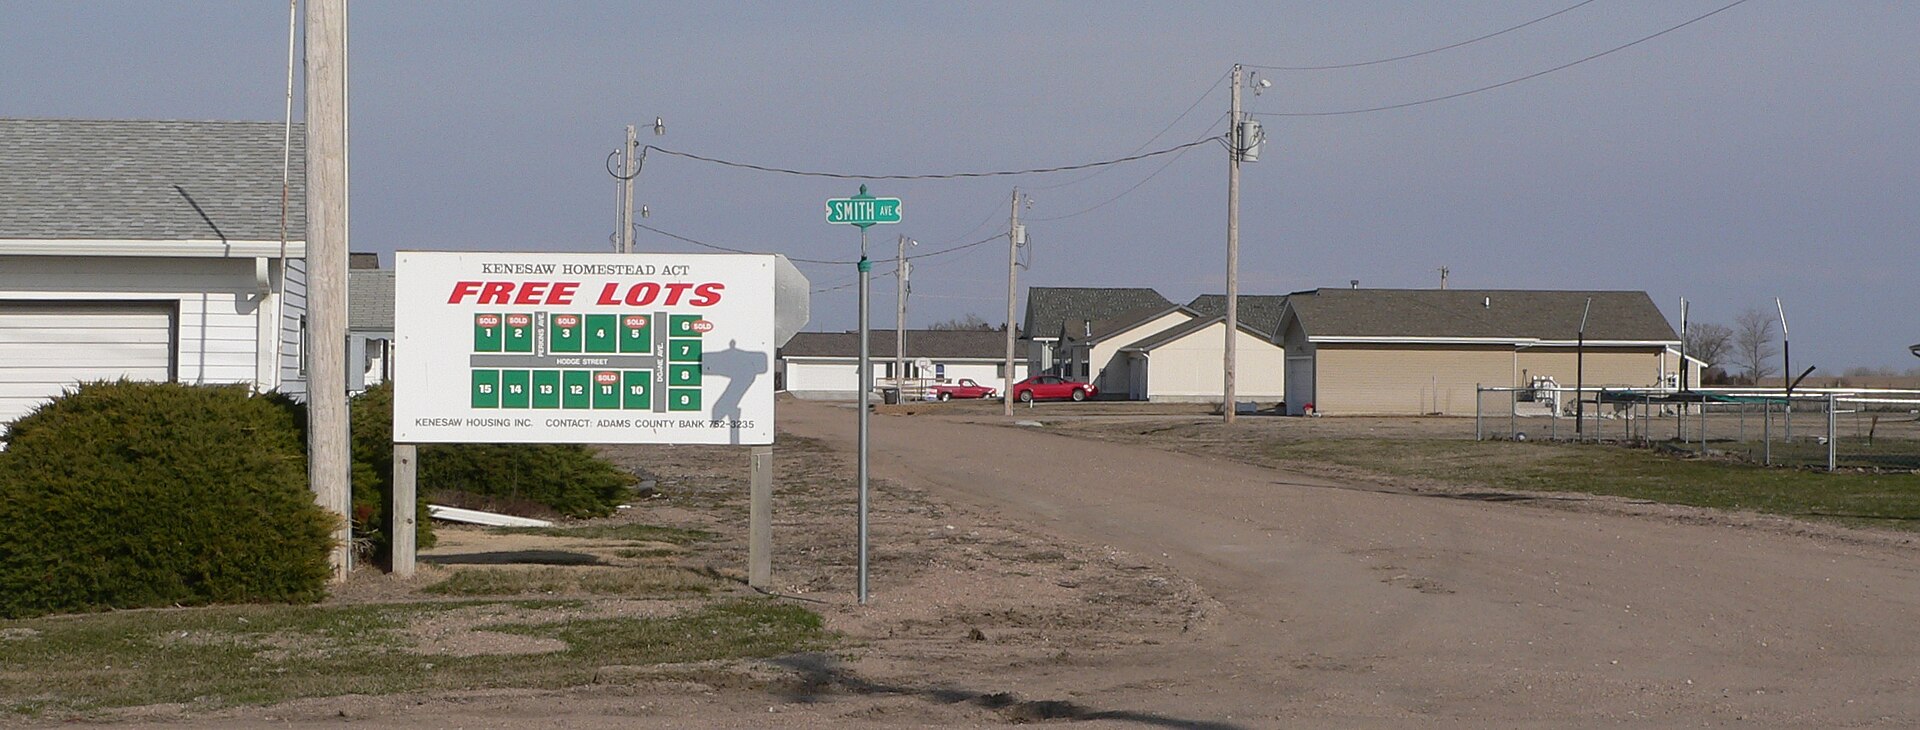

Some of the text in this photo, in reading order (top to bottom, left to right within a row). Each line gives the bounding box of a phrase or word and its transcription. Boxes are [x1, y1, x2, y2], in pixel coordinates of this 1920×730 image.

[835, 201, 893, 221] SMITH AVE
[482, 263, 690, 276] KENESAW HOMESTEAD ACT
[447, 281, 725, 307] FREE LOTS
[681, 321, 690, 331] 6
[485, 328, 492, 338] 1
[514, 328, 523, 338] 2
[562, 328, 571, 338] 3
[596, 329, 605, 338] 4
[631, 329, 640, 339] 5
[681, 346, 690, 356] 7
[556, 358, 609, 366] HODGE STREET
[681, 370, 690, 381] 8
[479, 384, 492, 394] 15
[509, 385, 522, 394] 14
[539, 385, 553, 395] 13
[570, 385, 583, 395] 12
[602, 385, 612, 395] 11
[630, 385, 644, 395] 10
[680, 395, 690, 405] 9
[415, 418, 462, 427] KENESAW
[466, 418, 511, 427] HOUSING
[514, 418, 533, 427] INC.
[545, 418, 593, 428] CONTACT:
[597, 419, 631, 428] ADAMS
[634, 419, 675, 428] COUNTY
[679, 419, 705, 428] BANK
